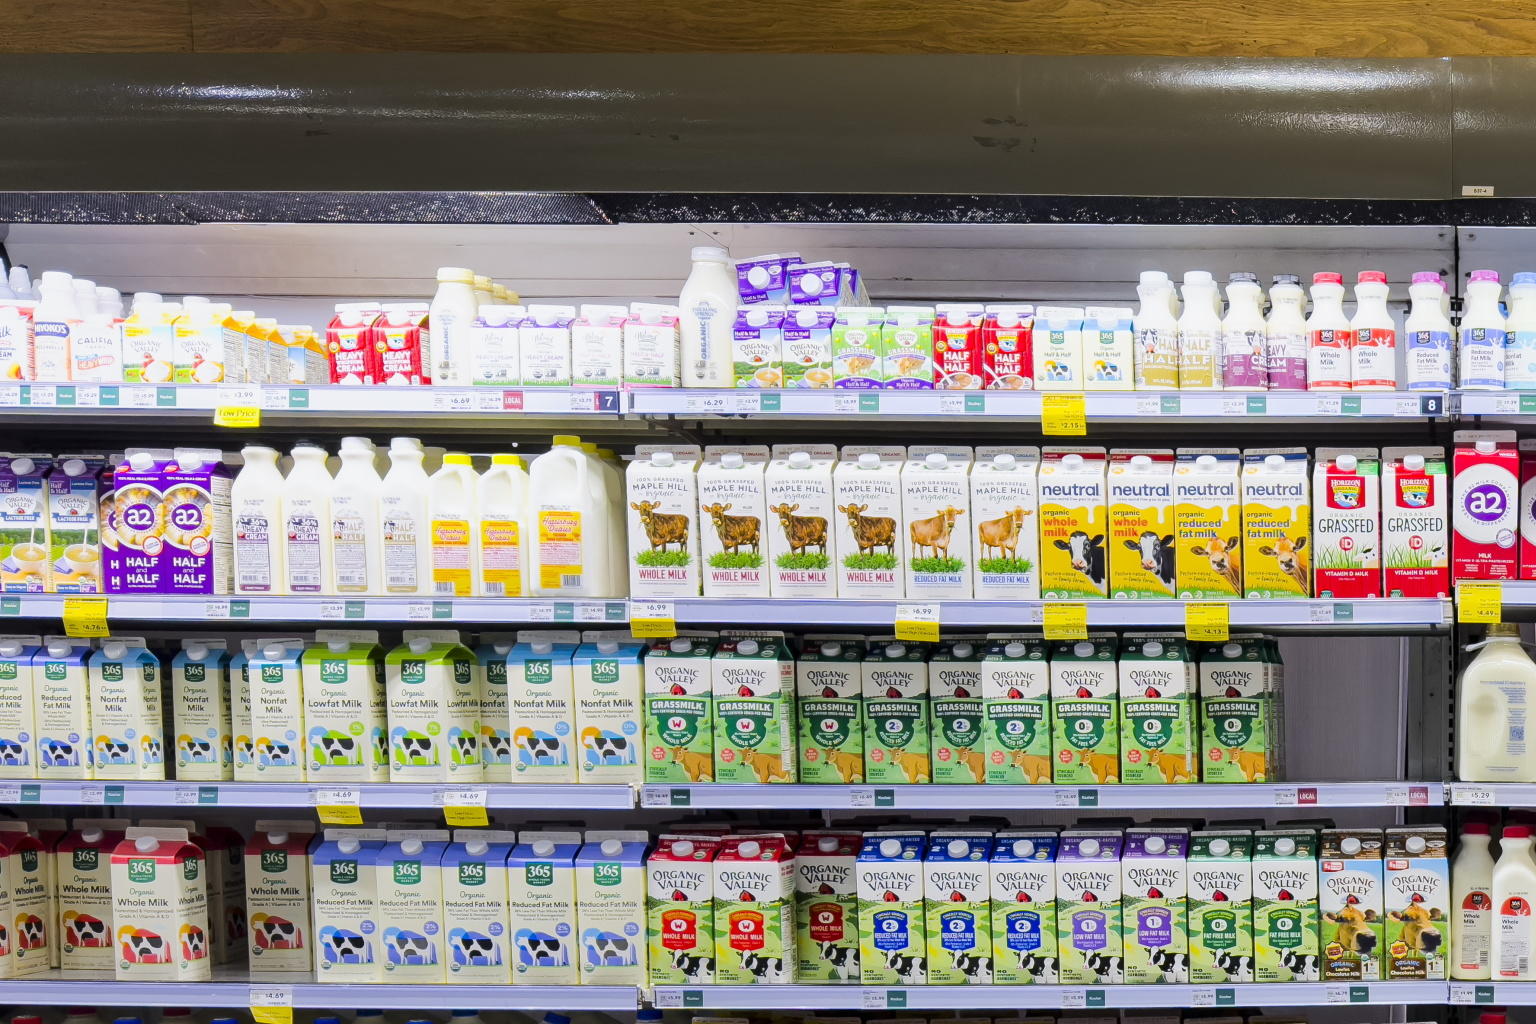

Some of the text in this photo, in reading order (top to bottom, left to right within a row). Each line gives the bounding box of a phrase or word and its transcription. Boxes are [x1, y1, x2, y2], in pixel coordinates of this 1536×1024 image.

[336, 351, 364, 362] HEAVY
[944, 352, 969, 362] HALF
[336, 364, 364, 372] CREAM
[944, 362, 970, 372] HALF
[504, 396, 521, 404] LOCAL
[604, 396, 614, 407] 7
[1428, 399, 1436, 411] 8
[704, 485, 735, 493] MAPLE
[1042, 484, 1100, 496] neutral
[1112, 485, 1169, 496] neutral
[1177, 483, 1234, 496] neutral
[1470, 492, 1502, 514] a2
[128, 509, 152, 524] a2
[175, 510, 199, 524] a2
[1043, 518, 1077, 527] whole
[1178, 519, 1222, 529] reduced
[1319, 519, 1373, 534] GRASSFED
[1388, 517, 1442, 533] GRASSFED
[1043, 528, 1068, 537] milk
[1178, 529, 1216, 538] fat milk
[126, 558, 158, 567] HALF
[173, 558, 206, 567] HALF
[127, 574, 159, 584] HALF
[174, 574, 206, 584] HALF
[639, 570, 687, 580] WHOLE MILK
[847, 573, 894, 582] WHOLE MILK
[323, 664, 344, 674] 365
[527, 664, 549, 676] 365
[722, 669, 766, 680] ORGANIC
[727, 676, 762, 686] VALLEY
[526, 689, 552, 697] Organic
[308, 700, 361, 709] Lowfat Milk
[514, 700, 567, 708] Nonfat Milk
[720, 702, 771, 711] GRASSMILK
[131, 862, 152, 874] 365
[653, 870, 705, 883] ORGANIC
[658, 880, 700, 890] VALLEY
[117, 898, 169, 907] Whole Milk
